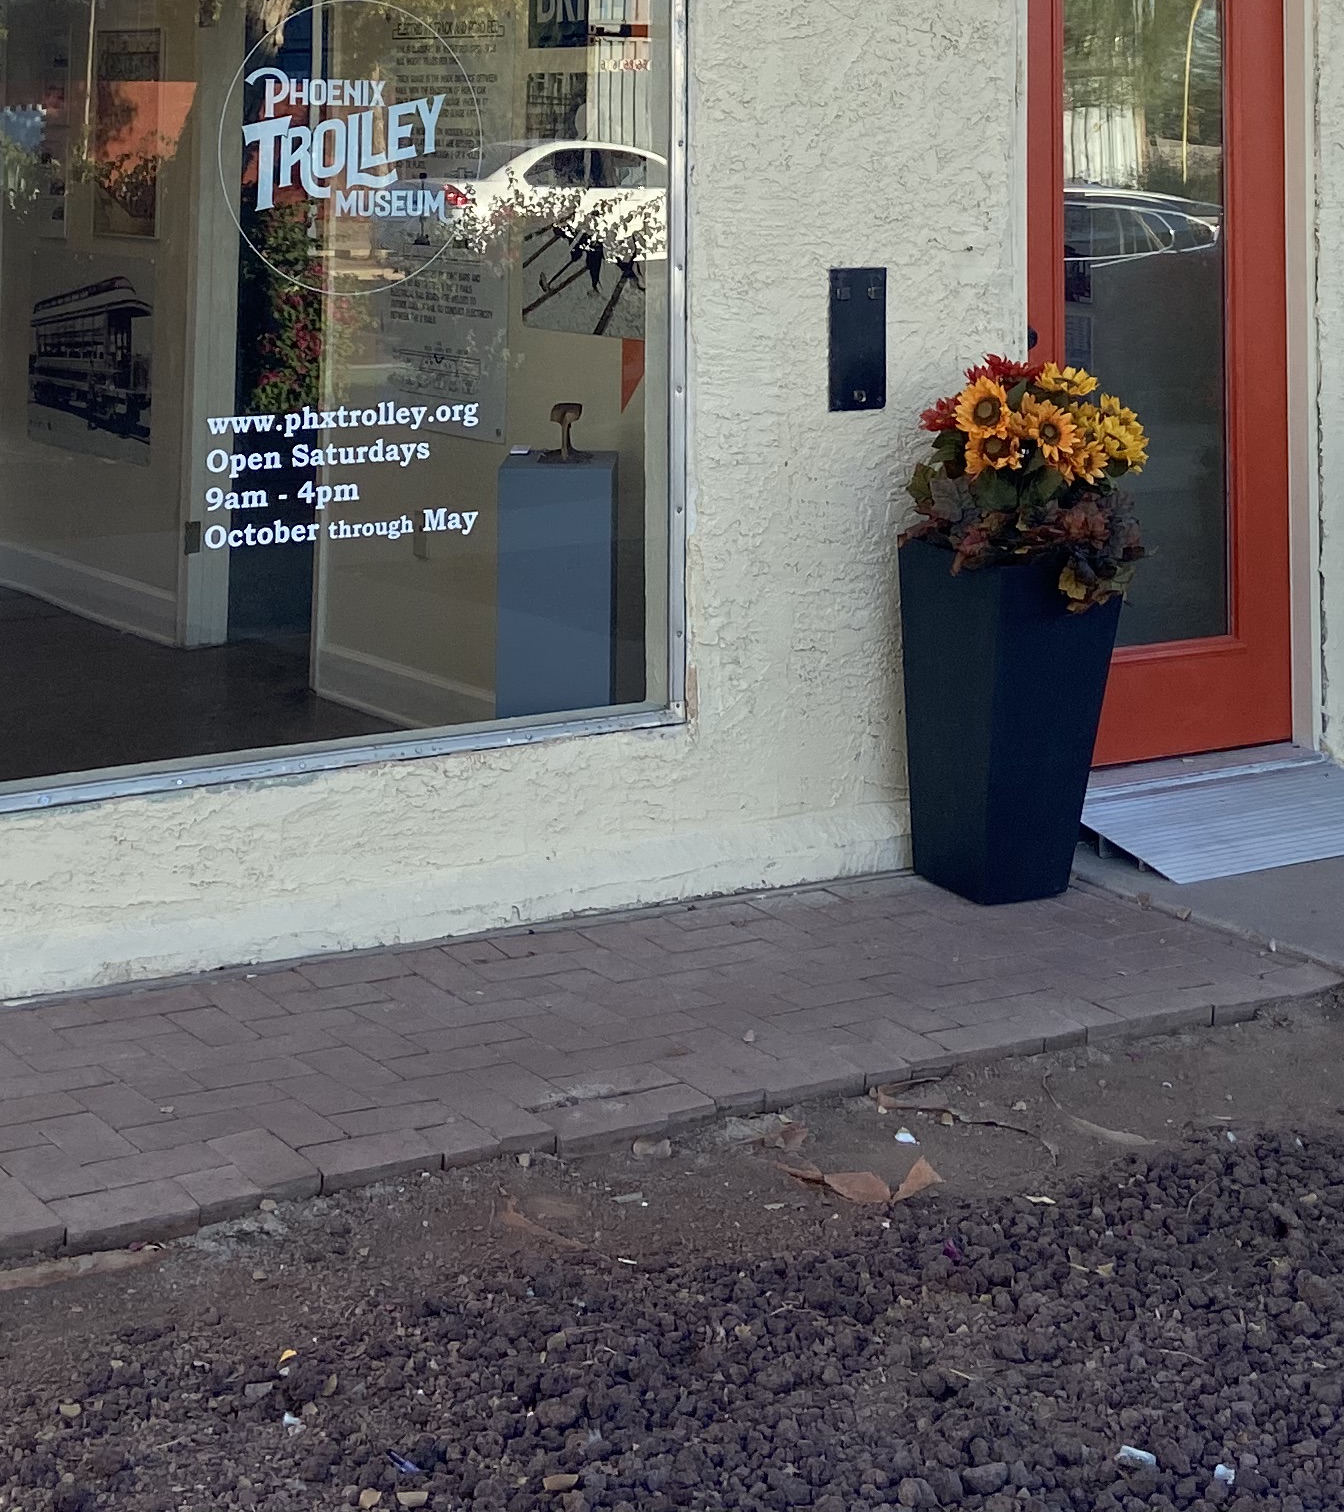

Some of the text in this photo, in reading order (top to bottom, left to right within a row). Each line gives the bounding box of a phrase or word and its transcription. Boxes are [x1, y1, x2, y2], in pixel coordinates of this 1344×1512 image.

[244, 67, 387, 118] PHOENIX
[242, 93, 447, 212] TROLLEY
[335, 190, 452, 224] MUSEUM
[207, 401, 479, 437] www.phxtrolley.org
[206, 438, 431, 478] Open Saturdays
[205, 486, 269, 511] 9am
[297, 480, 360, 510] 4pm
[204, 507, 479, 550] October through May
